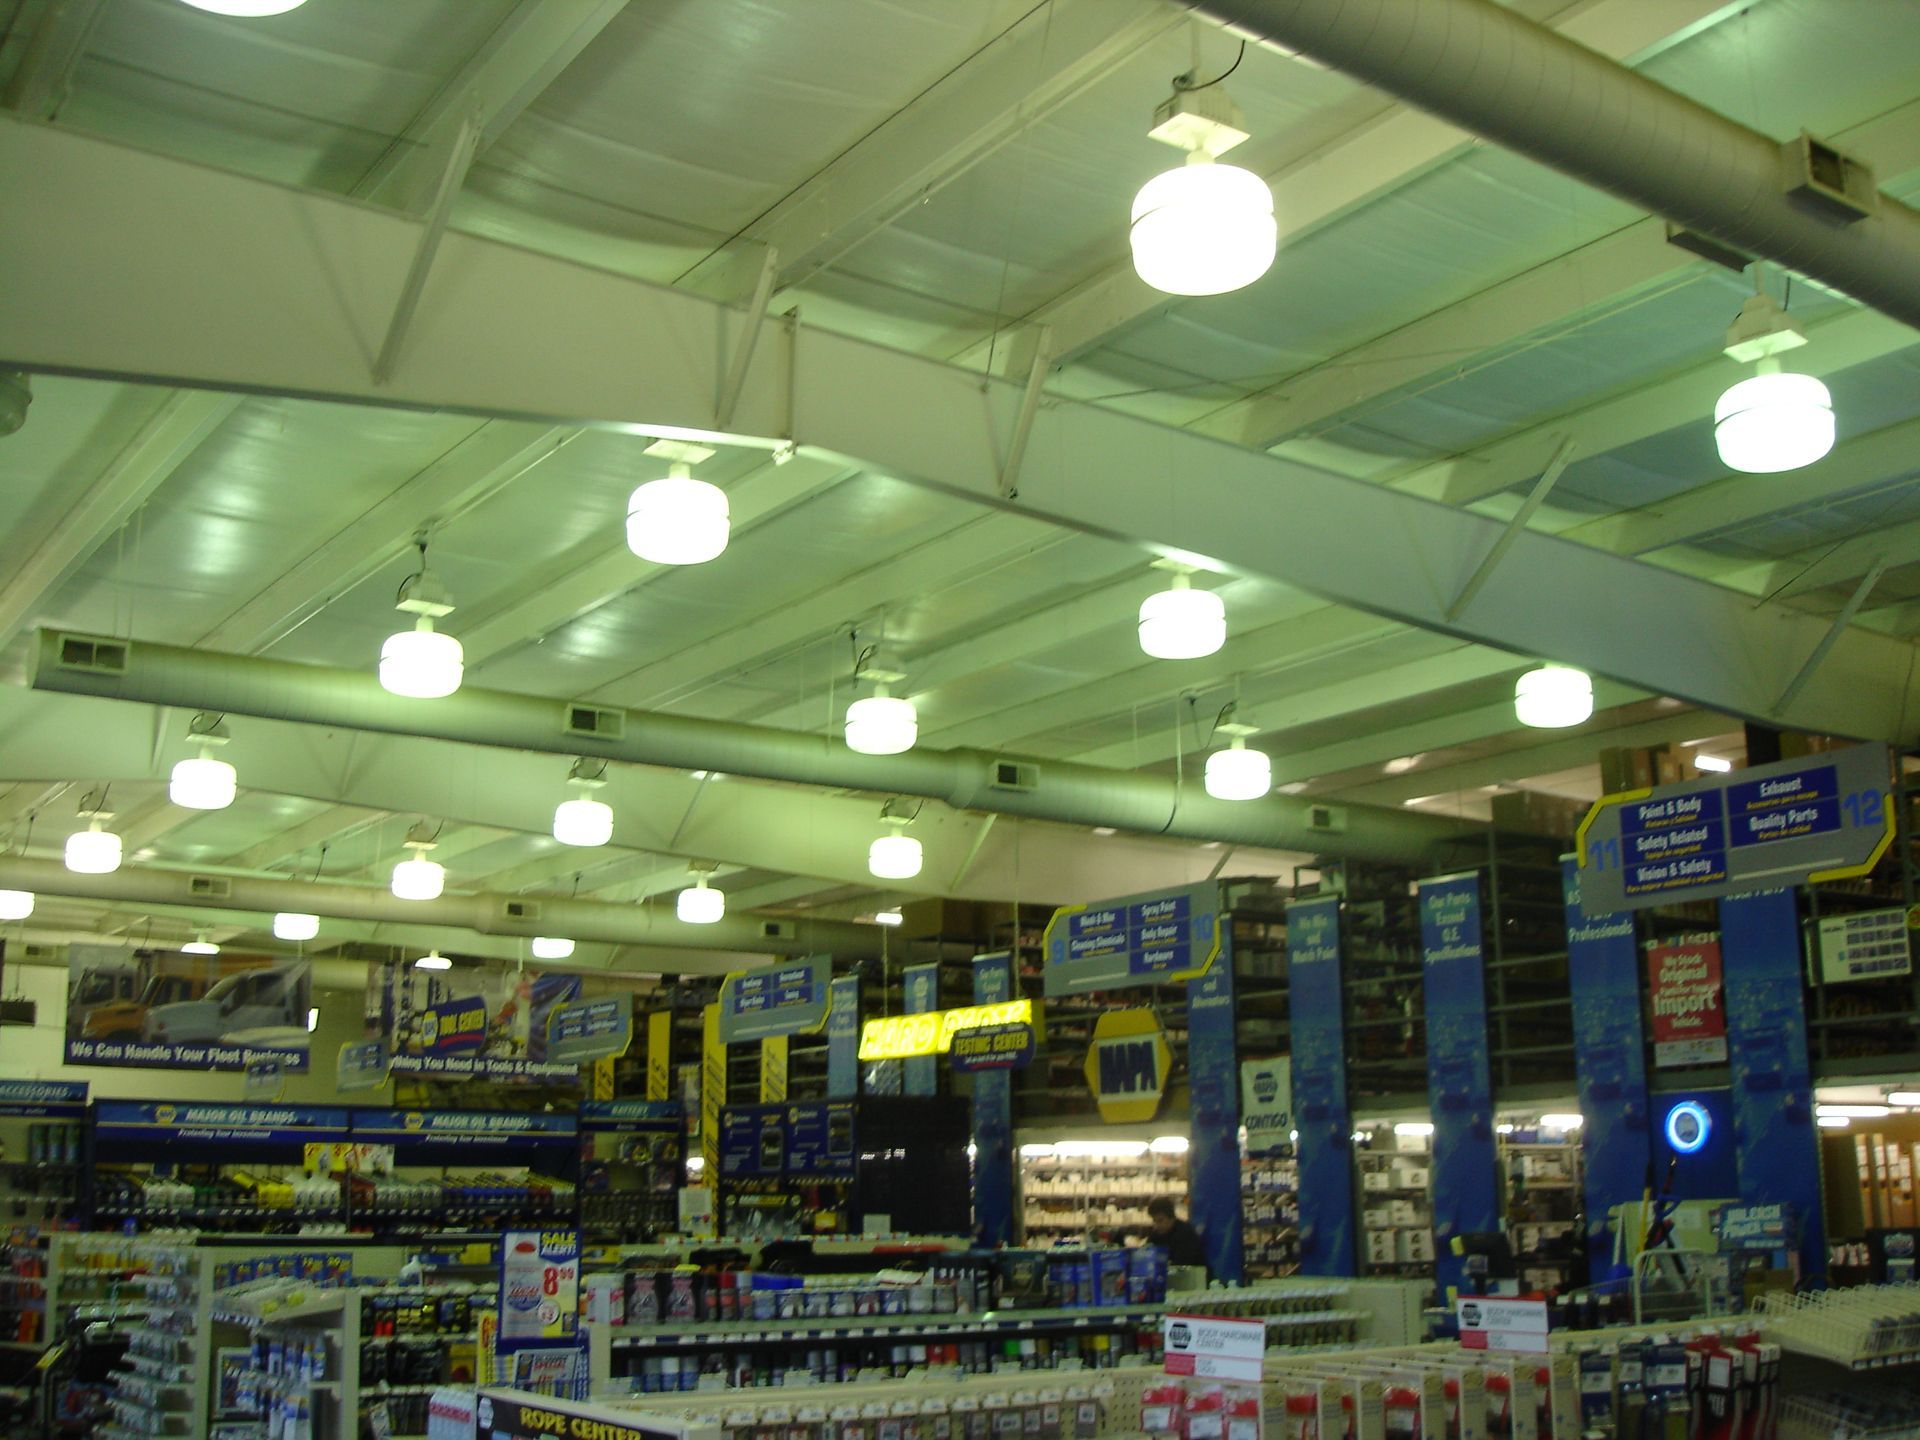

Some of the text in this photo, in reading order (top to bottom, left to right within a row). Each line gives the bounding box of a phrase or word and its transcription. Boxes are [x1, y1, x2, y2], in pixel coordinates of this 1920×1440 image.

[1759, 777, 1803, 798] Exhaust
[1639, 804, 1665, 821] Paint
[1666, 801, 1675, 816] &
[1677, 796, 1702, 814] Body
[1750, 806, 1819, 832] Quality Parts
[1841, 789, 1884, 828] 12
[1636, 826, 1708, 853] Safety Related
[1590, 838, 1618, 872] 11
[1637, 858, 1712, 883] Vision & Safety
[1194, 911, 1214, 941] 10
[1568, 920, 1633, 943] Professionals
[1052, 938, 1065, 965] 9
[1660, 963, 1708, 985] Original
[1653, 989, 1716, 1017] Import
[439, 1008, 486, 1036] TOOL CENTER
[70, 1040, 93, 1057] We
[96, 1041, 121, 1058] Can
[125, 1043, 172, 1061] Handle
[174, 1045, 205, 1063] Your
[207, 1047, 240, 1064] Fleet
[954, 1031, 1029, 1057] TESTING CENTER
[423, 1057, 445, 1072] You
[446, 1058, 473, 1072] Need
[474, 1058, 485, 1072] in
[486, 1059, 514, 1074] Tools
[514, 1060, 524, 1073] &
[525, 1060, 578, 1077] Equipment
[1100, 1041, 1157, 1095] NAPA
[186, 1108, 227, 1122] MAJOR
[229, 1109, 248, 1123] OIL
[432, 1115, 470, 1128] MAJOR
[471, 1116, 487, 1128] OIL
[1245, 1112, 1289, 1130] CONTIGO
[541, 1244, 577, 1257] ALERT!
[542, 1231, 577, 1246] SALE
[519, 1406, 642, 1440] ROPE CENTER
